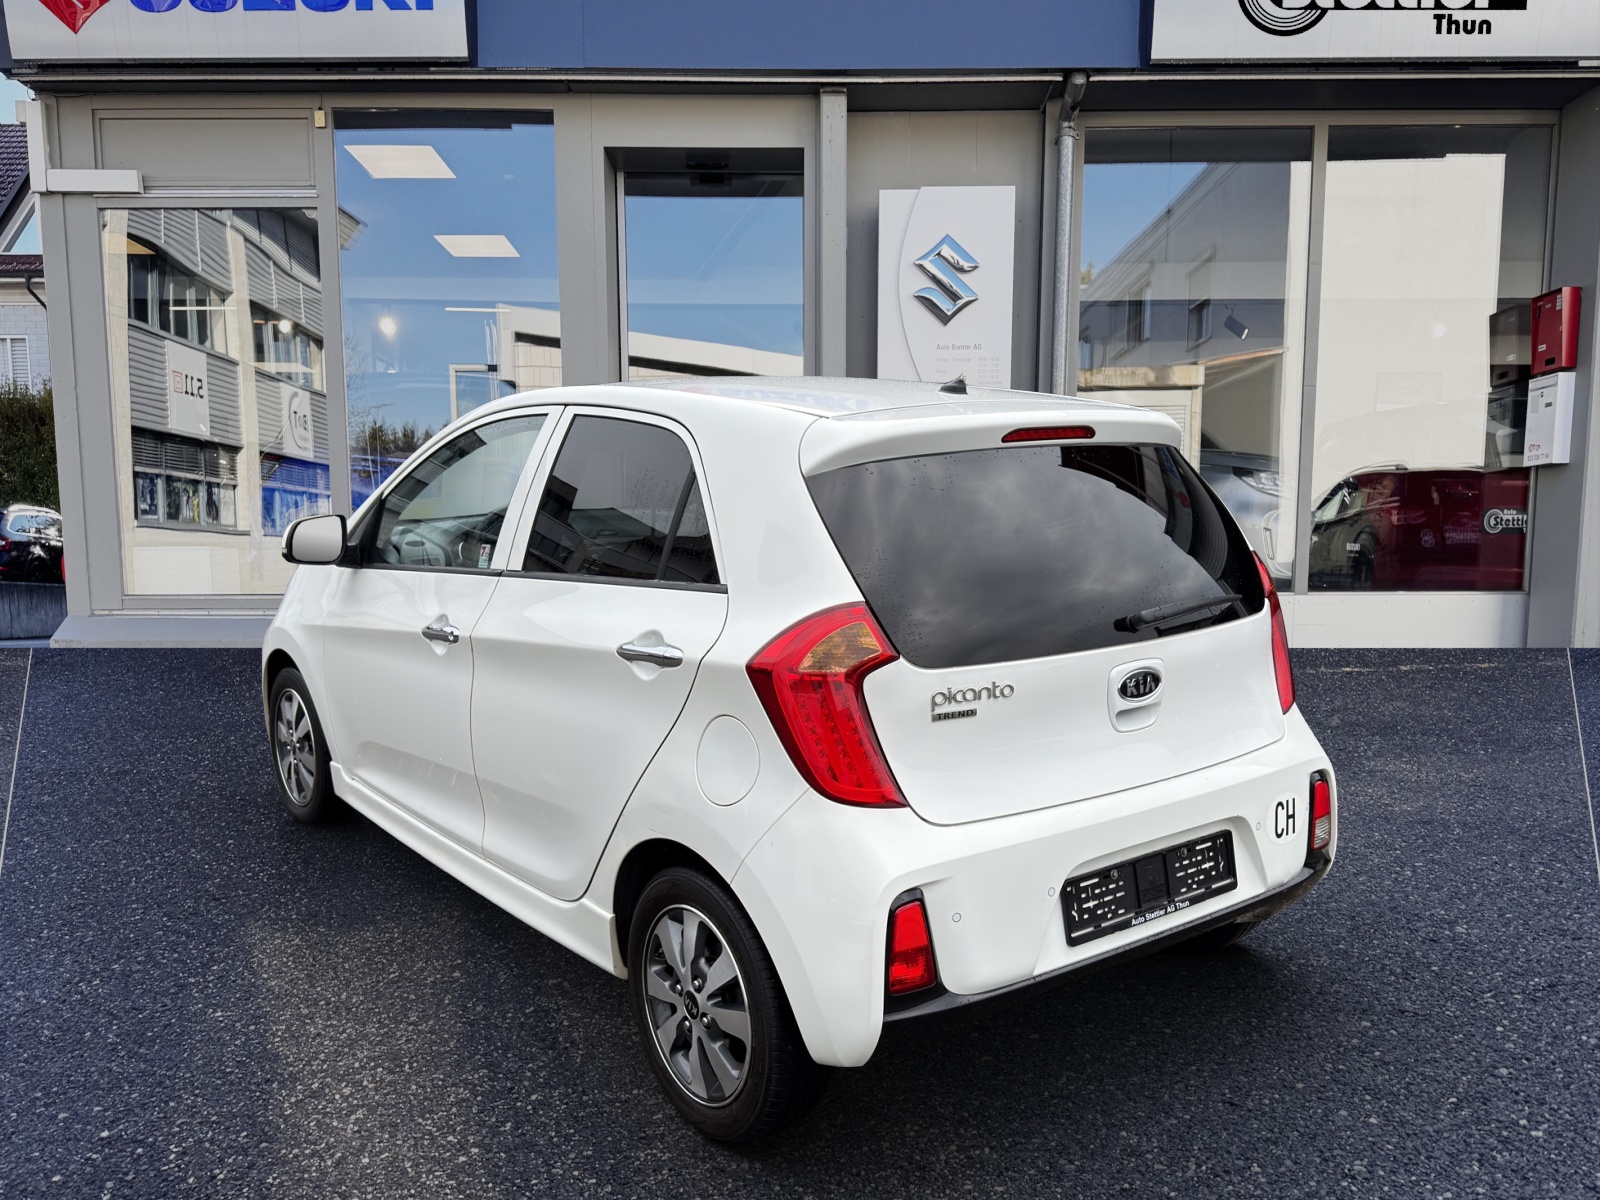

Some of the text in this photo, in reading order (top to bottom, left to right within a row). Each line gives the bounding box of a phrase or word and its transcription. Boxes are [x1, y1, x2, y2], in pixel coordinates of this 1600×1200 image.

[1433, 13, 1492, 35] Thun
[936, 343, 982, 351] Auto Stettler AG
[930, 680, 1015, 713] picanto
[1126, 674, 1156, 697] KIA
[936, 709, 974, 721] TREND
[1274, 797, 1296, 839] CH
[1132, 901, 1190, 926] Auto Stettler AG Thun
